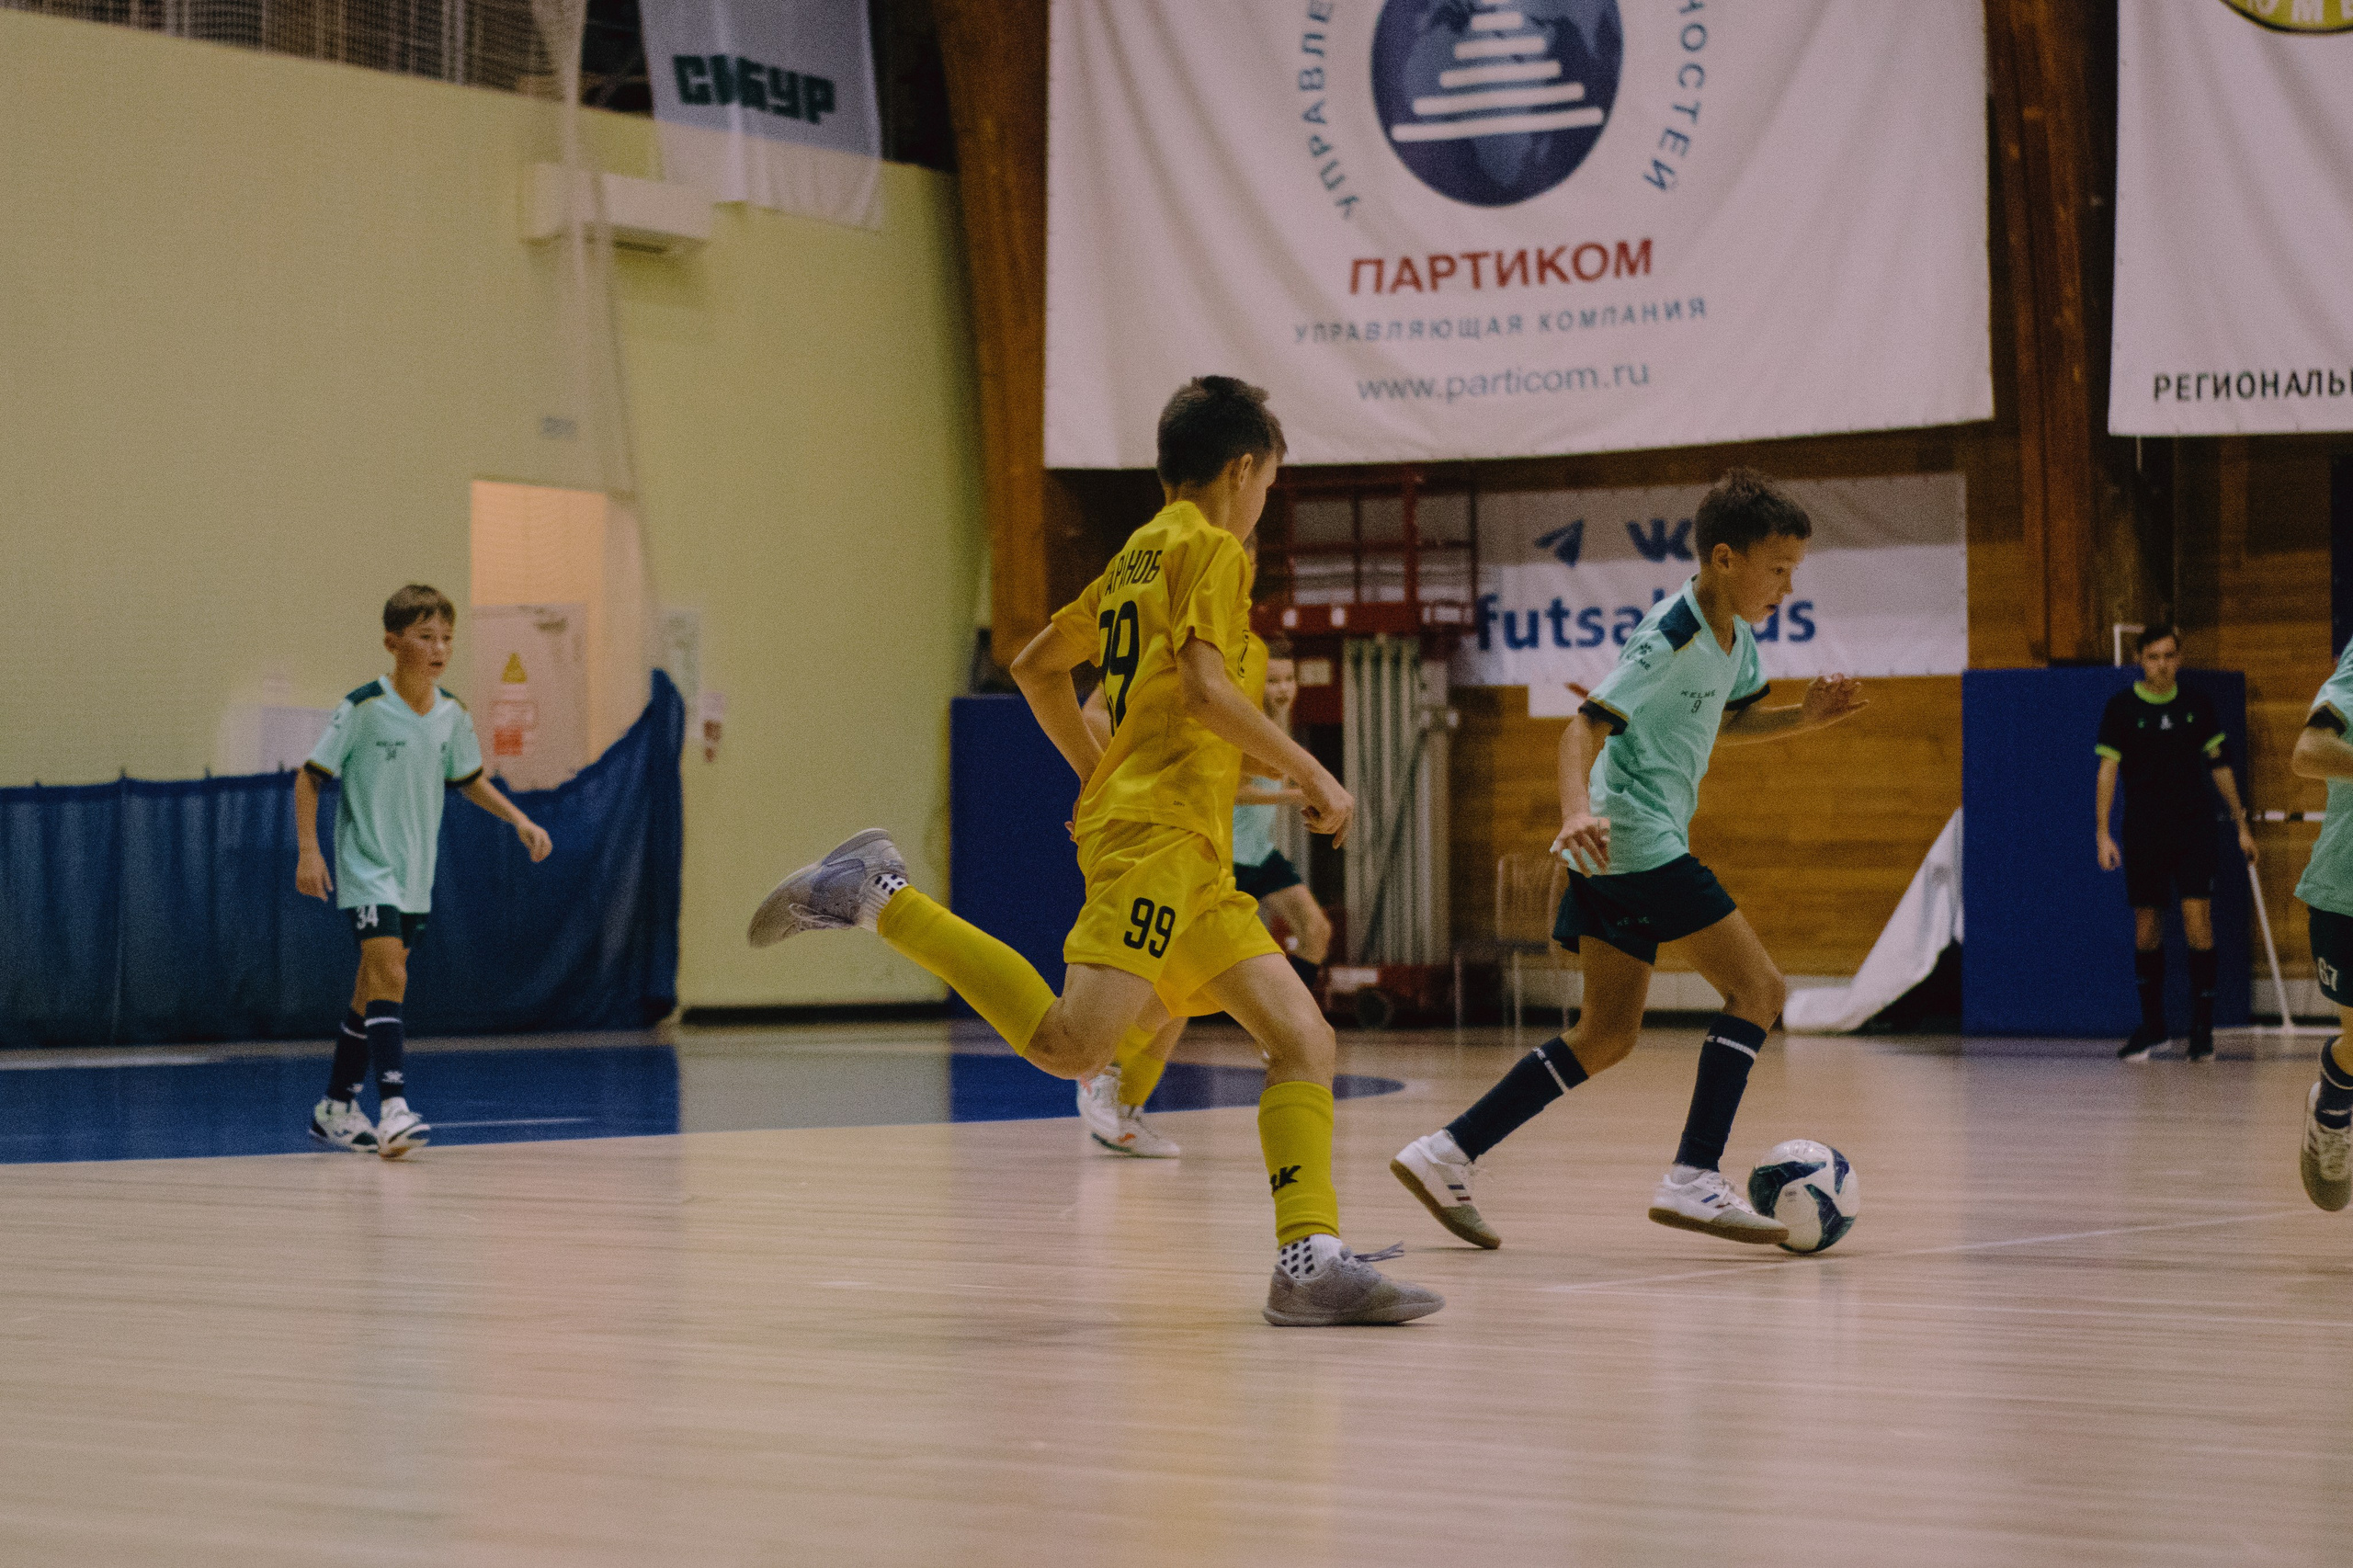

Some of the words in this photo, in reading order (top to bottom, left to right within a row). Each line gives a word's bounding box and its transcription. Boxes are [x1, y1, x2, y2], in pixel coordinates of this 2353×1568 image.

[1348, 237, 1654, 296] ПАРТИКОМ
[1293, 313, 1524, 344] УПРАВЛЯЮЩАЯ
[1538, 296, 1708, 333] КОМПАНИЯ
[1357, 362, 1651, 403] www.particom.ru
[2153, 369, 2353, 402] РЕГИОНАЛЬ
[1690, 699, 1702, 714] 9
[1123, 897, 1176, 959] 99
